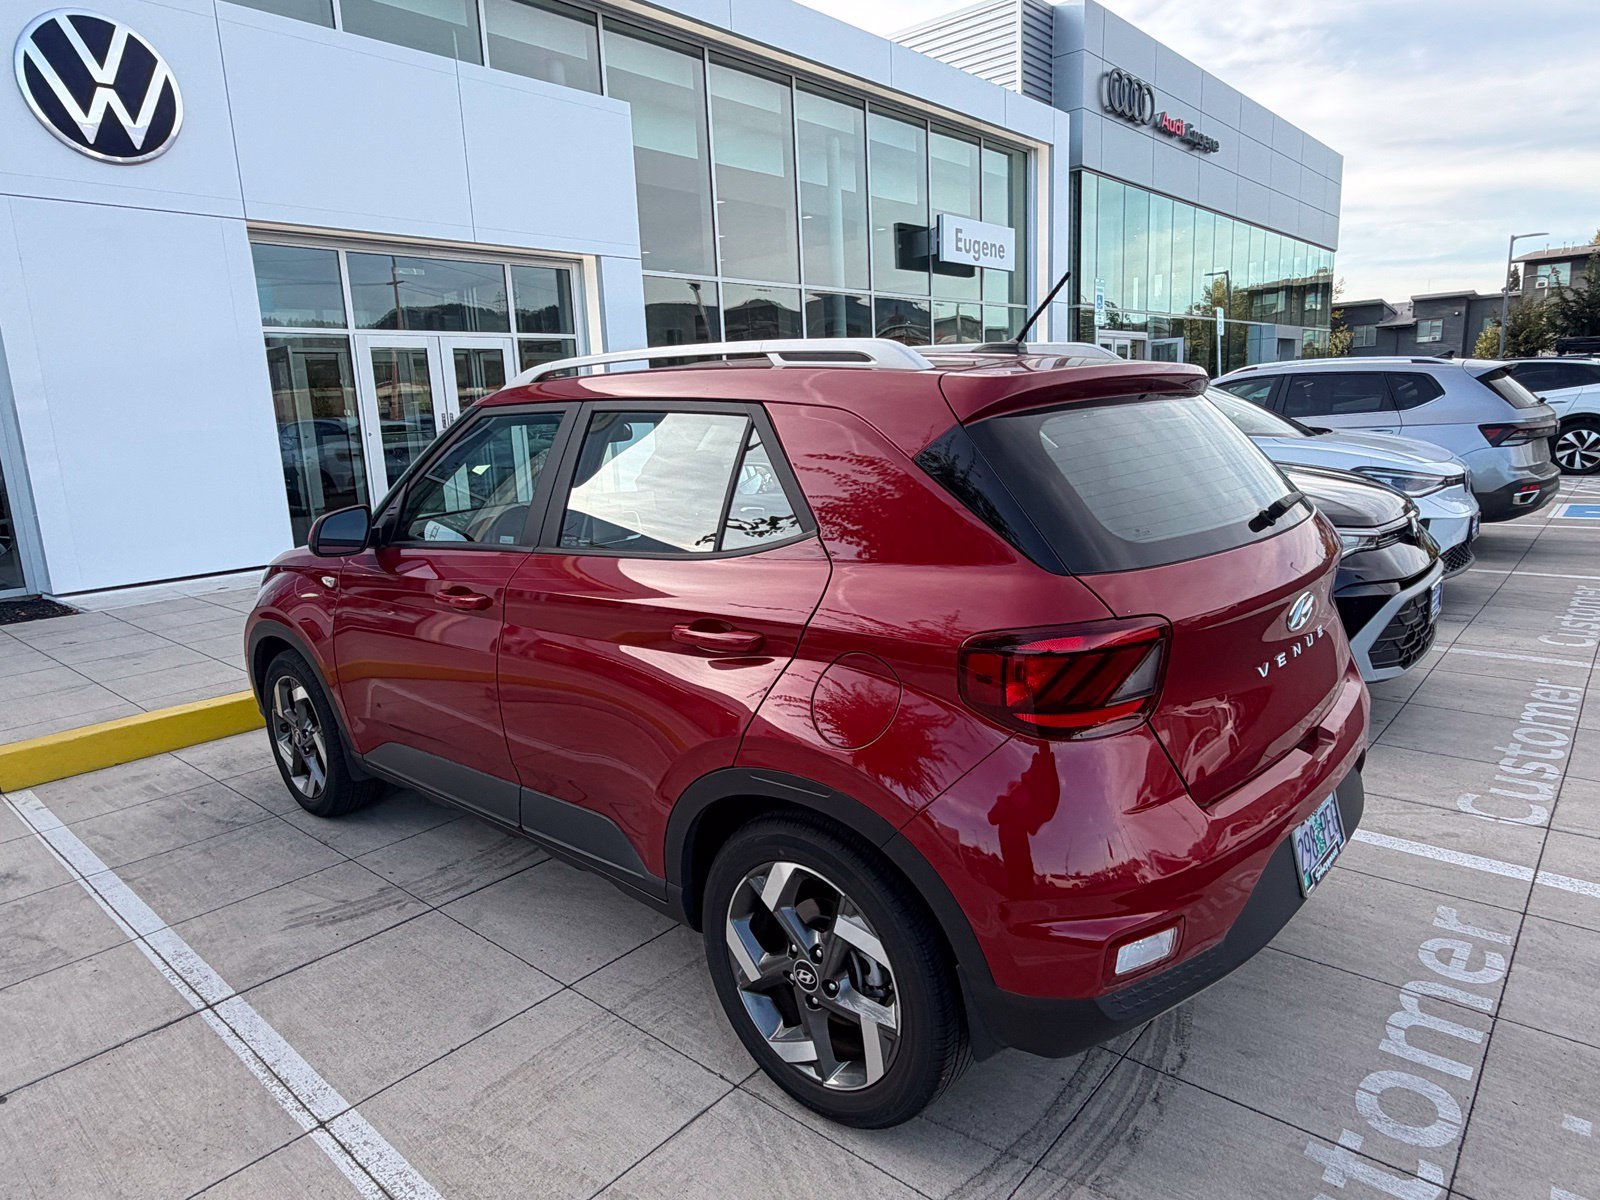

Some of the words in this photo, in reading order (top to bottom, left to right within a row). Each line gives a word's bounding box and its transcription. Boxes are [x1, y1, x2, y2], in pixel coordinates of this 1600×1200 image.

[1161, 111, 1185, 137] Audi
[954, 227, 1006, 261] Eugene
[1537, 584, 1600, 647] Customer
[1256, 624, 1325, 678] VENUE
[1456, 677, 1584, 825] Customer
[1297, 824, 1320, 875] 298
[1303, 905, 1512, 1200] tomer
